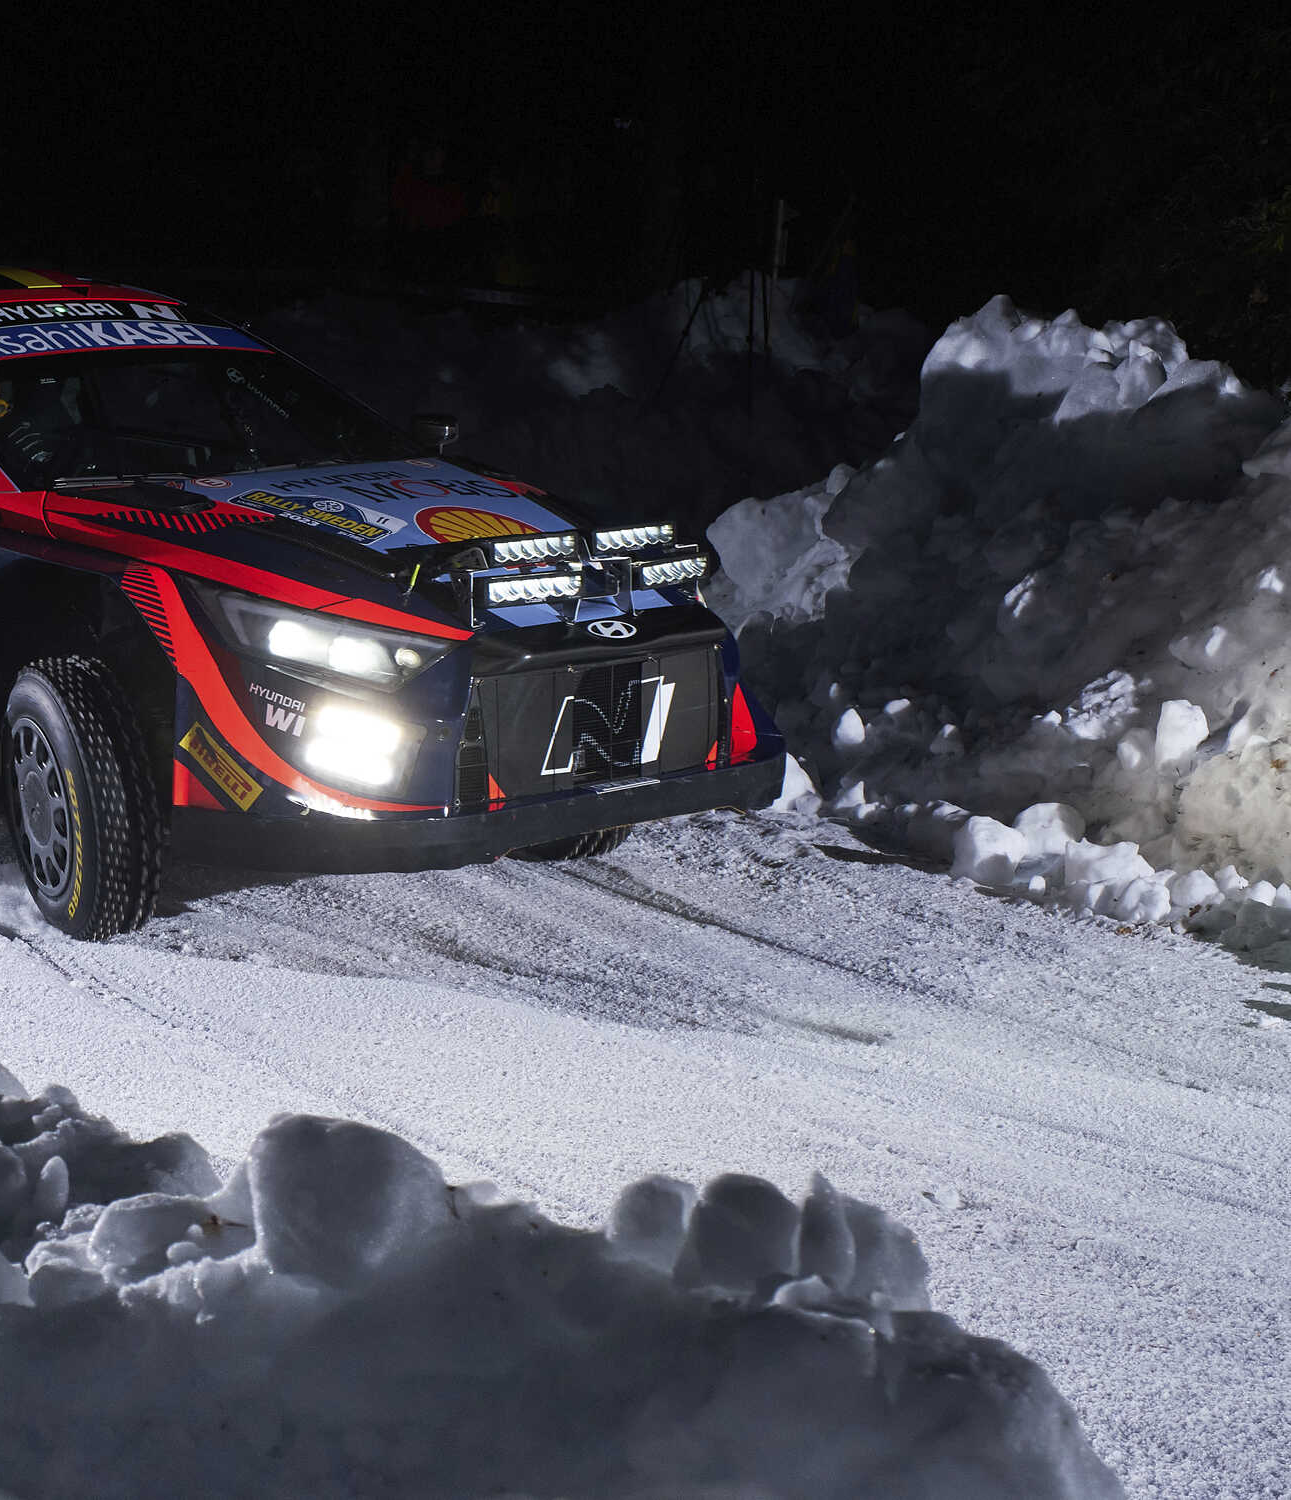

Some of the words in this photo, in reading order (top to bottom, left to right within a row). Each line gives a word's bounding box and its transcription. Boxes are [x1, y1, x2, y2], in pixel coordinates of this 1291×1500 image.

[270, 471, 411, 492] HYUNDAI
[344, 478, 520, 503] MOBIS
[247, 491, 306, 514] RALLY
[304, 509, 384, 539] SWEDEN
[249, 683, 306, 713] HYUNDAI
[188, 726, 253, 801] PIRELLI
